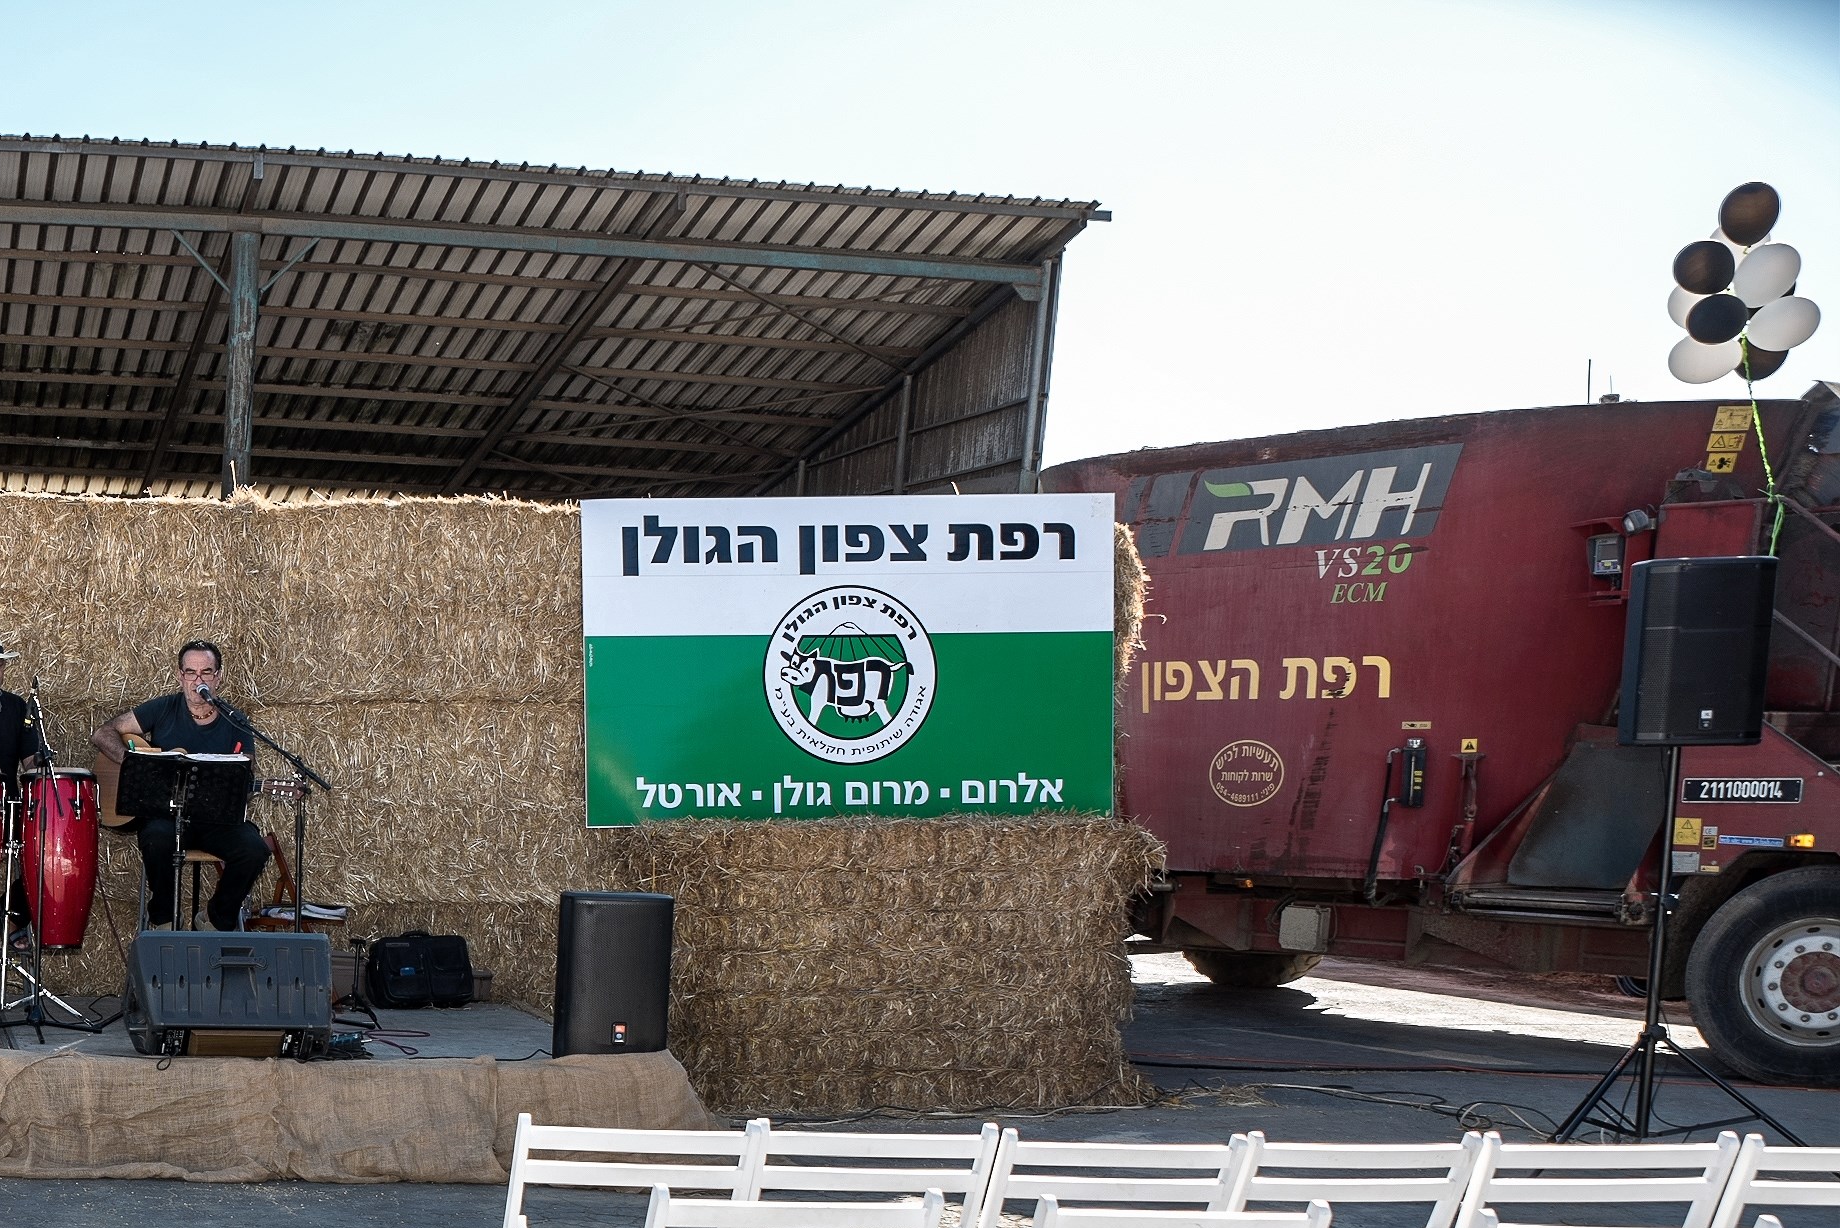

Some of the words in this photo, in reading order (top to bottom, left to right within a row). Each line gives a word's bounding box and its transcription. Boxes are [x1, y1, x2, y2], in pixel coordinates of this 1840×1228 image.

[1203, 462, 1433, 551] RMH
[621, 515, 780, 577] הגולן
[798, 523, 929, 576] צפון
[946, 521, 1077, 562] רפת
[832, 595, 878, 610] צפון
[1330, 581, 1388, 604] ECM
[781, 600, 829, 643] הגולן
[879, 602, 918, 641] רפת
[798, 659, 894, 707] רפת
[1141, 658, 1261, 714] הצפון
[1279, 655, 1392, 701] רפת
[904, 685, 927, 728] אגודה
[796, 728, 846, 756] חקלאית
[851, 728, 903, 756] שיתופית
[1215, 745, 1239, 770] לכיש
[1241, 745, 1279, 772] תעשיות
[636, 776, 742, 809] אורטל
[961, 772, 1064, 804] אלרום
[1220, 769, 1250, 783] לקוחות
[1251, 771, 1274, 782] שרות
[1699, 780, 1783, 799] 2111000014
[773, 775, 832, 813] גולן
[845, 779, 930, 807] מרום
